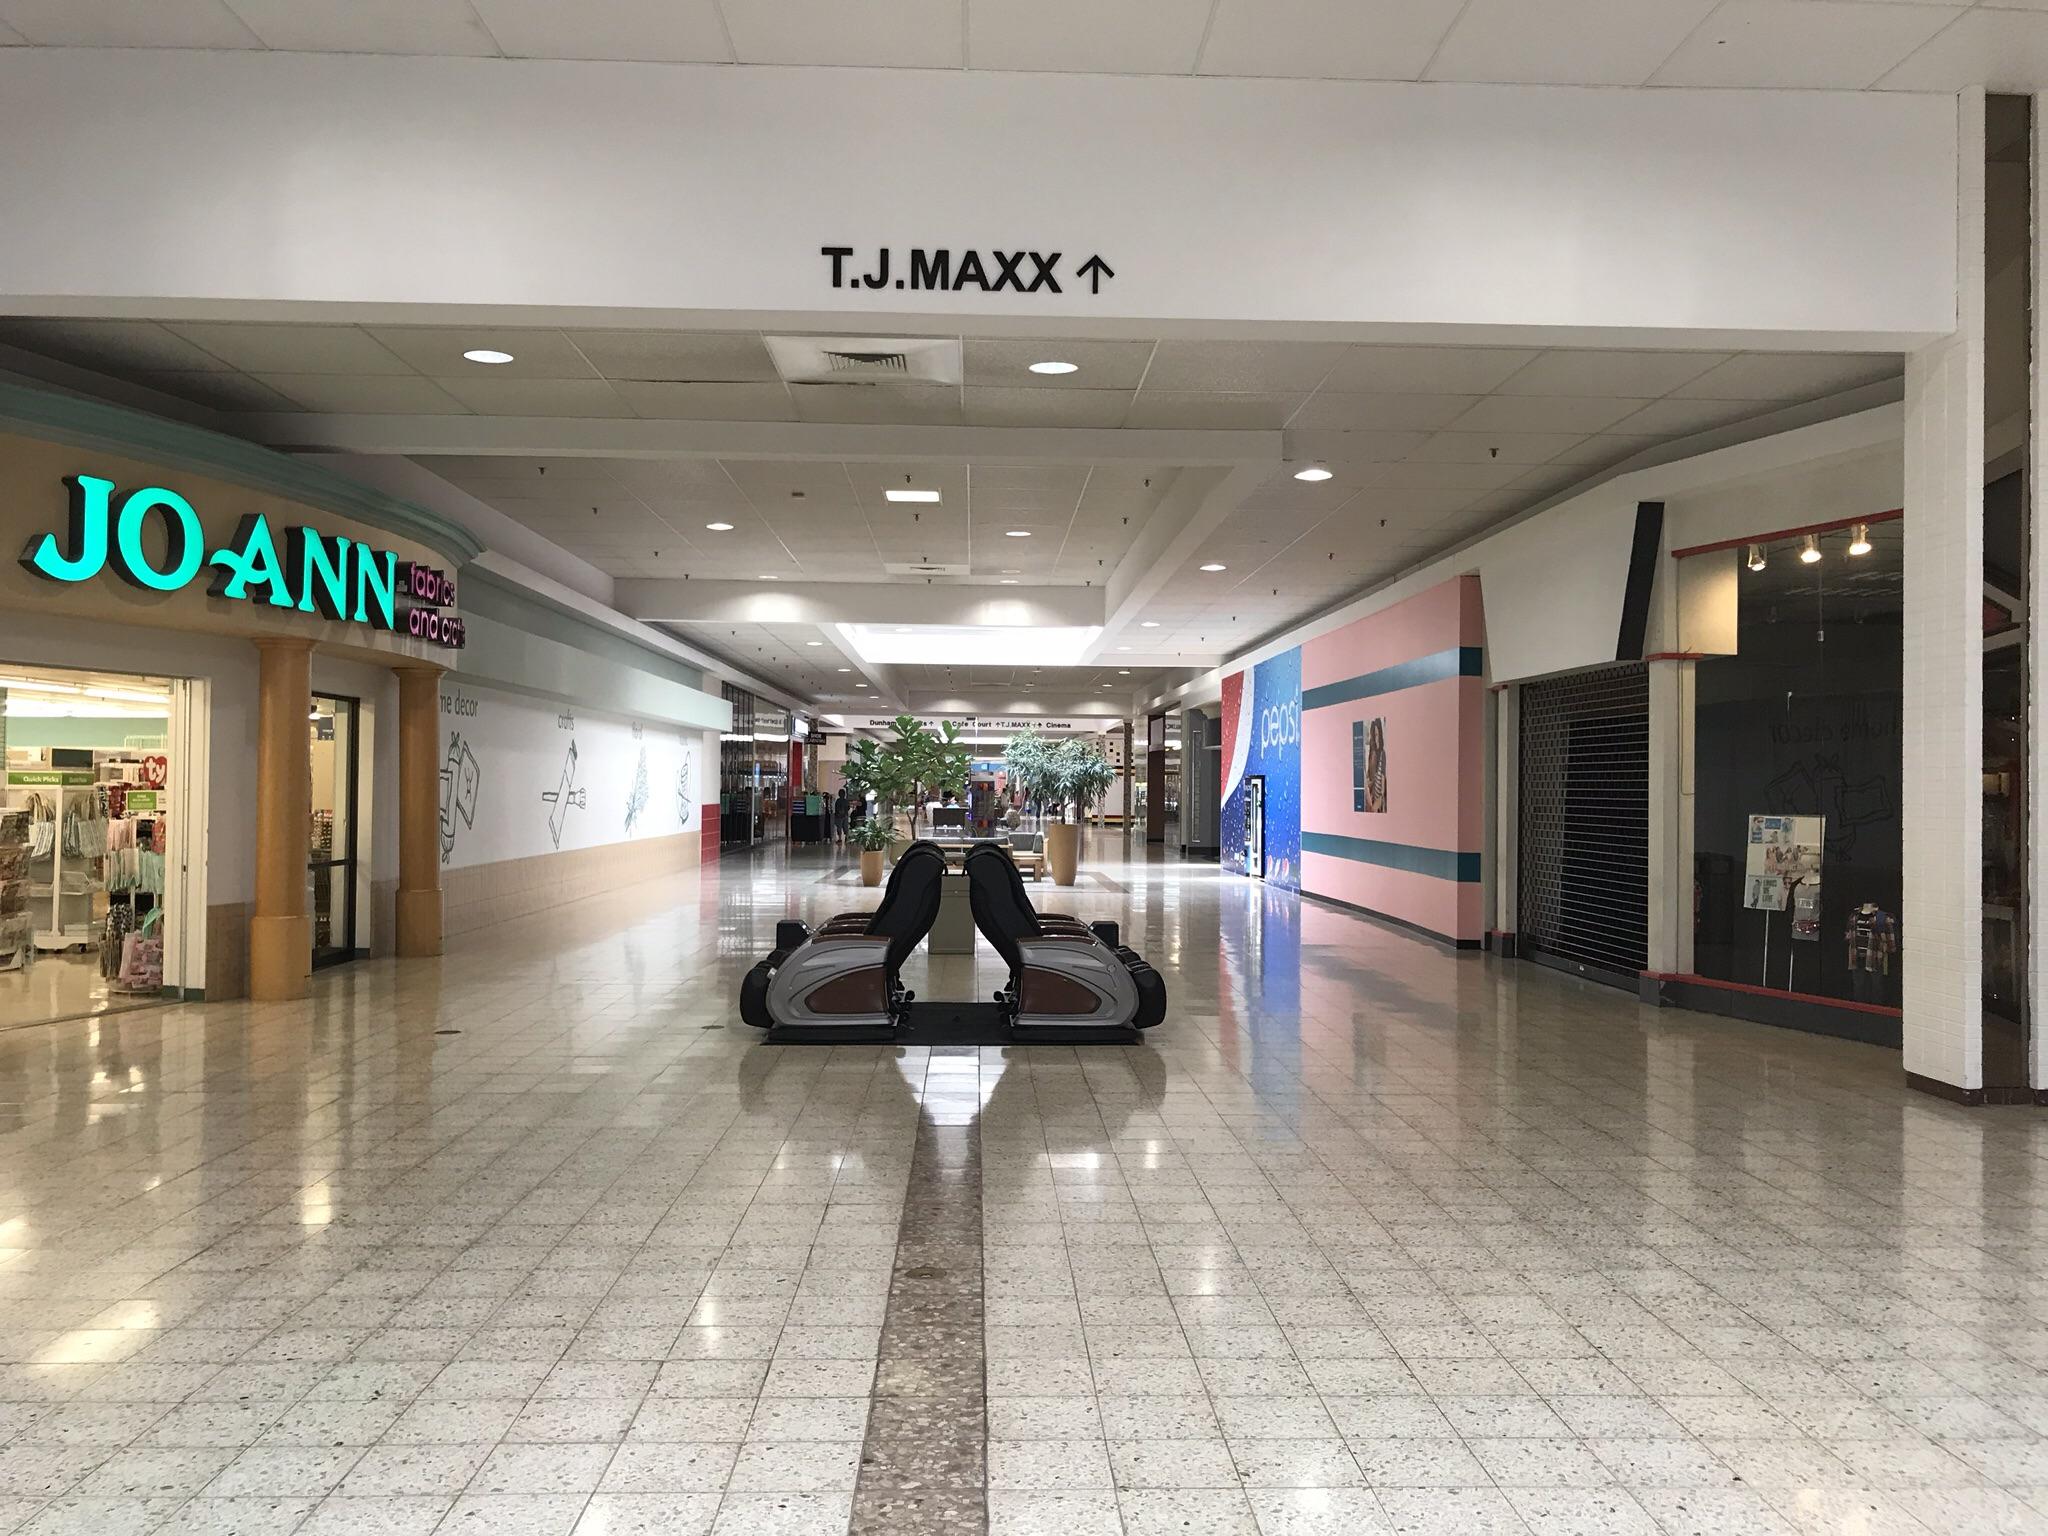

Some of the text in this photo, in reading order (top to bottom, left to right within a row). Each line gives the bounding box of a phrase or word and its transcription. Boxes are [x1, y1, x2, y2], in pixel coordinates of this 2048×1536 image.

[820, 246, 1064, 294] T.J.MAXX
[409, 608, 439, 640] and
[440, 688, 478, 717] me decor
[1046, 721, 1071, 729] Cinema
[1260, 699, 1300, 760] pepsi
[23, 775, 42, 783] Quick
[43, 775, 59, 784] Picks
[145, 757, 166, 783] ty
